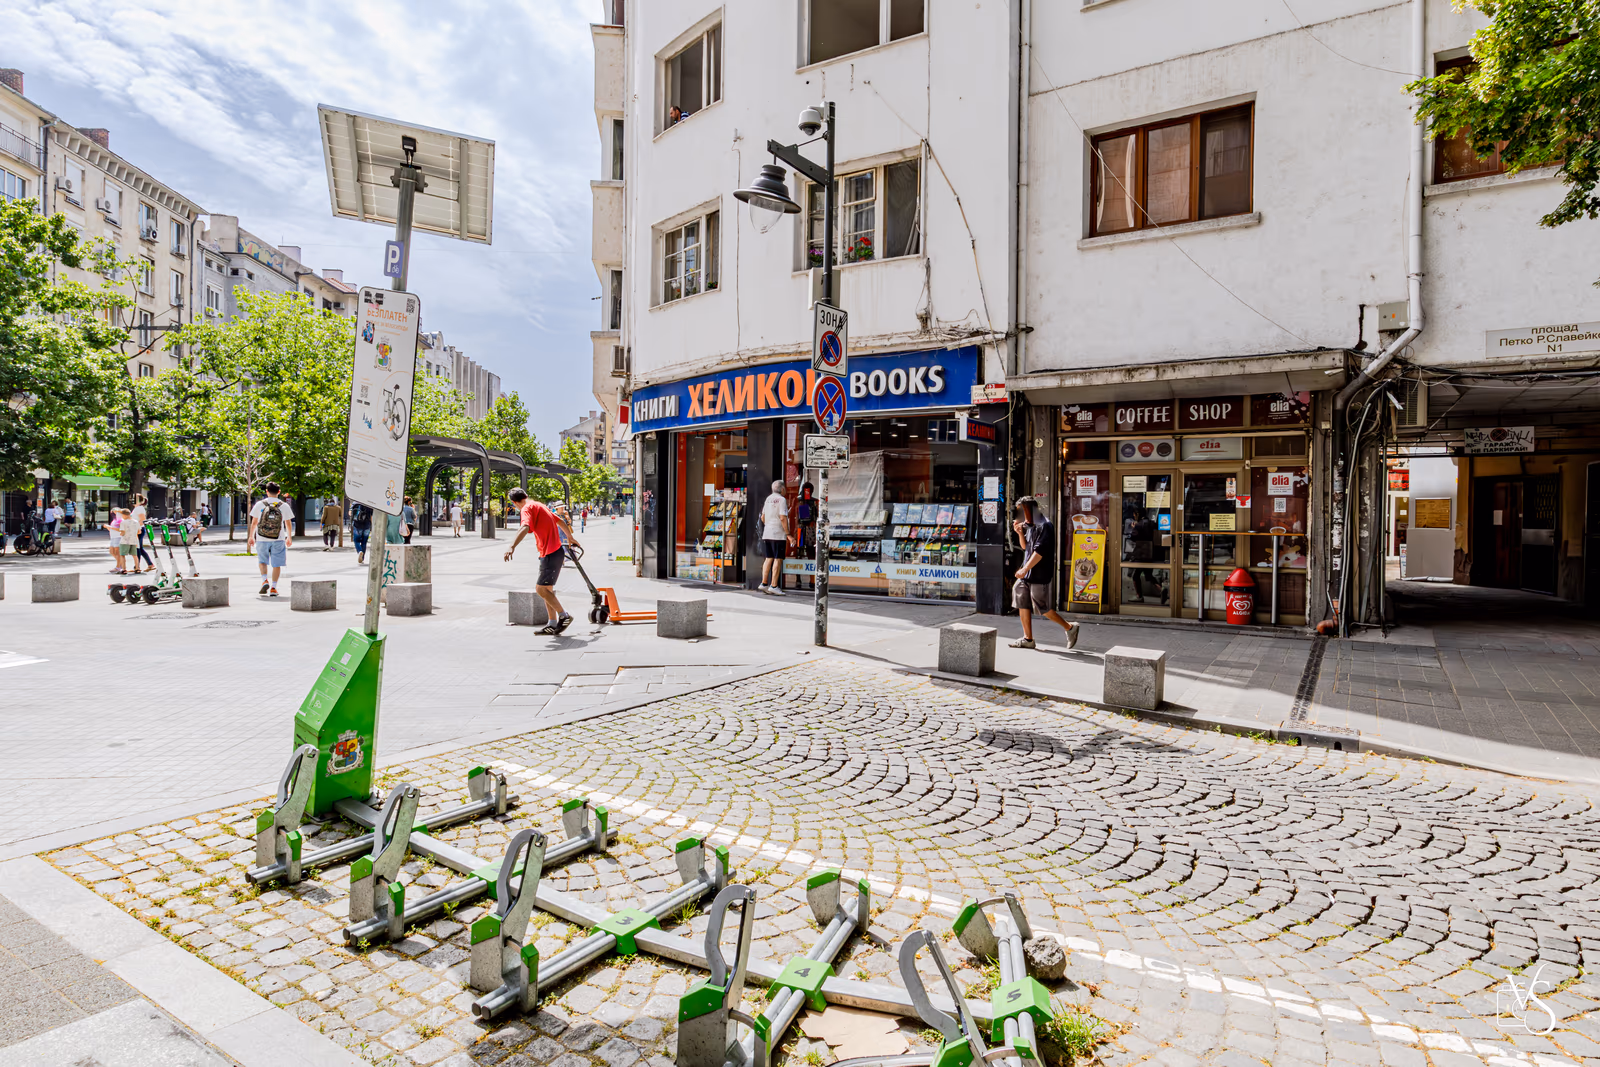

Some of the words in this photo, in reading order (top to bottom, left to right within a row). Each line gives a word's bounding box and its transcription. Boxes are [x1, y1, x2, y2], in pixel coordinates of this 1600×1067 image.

[387, 245, 400, 273] P
[367, 308, 408, 323] БЕЗПЛАТЕН
[820, 309, 843, 330] ЗОНА
[1532, 324, 1579, 334] площад
[1499, 338, 1533, 347] Петко
[634, 394, 678, 422] КНИГИ
[850, 365, 945, 398] BOOKS
[1270, 400, 1289, 412] elia
[1077, 410, 1093, 421] elia
[1116, 406, 1170, 424] COFFEE
[1189, 403, 1231, 420] SHOP
[1199, 440, 1220, 449] elia
[1079, 478, 1094, 488] elia
[1271, 475, 1290, 486] elia
[841, 565, 860, 573] BOOKS
[896, 568, 917, 576] КНИГИ
[919, 568, 959, 579] ХЕЛИКОН
[793, 967, 811, 978] 4
